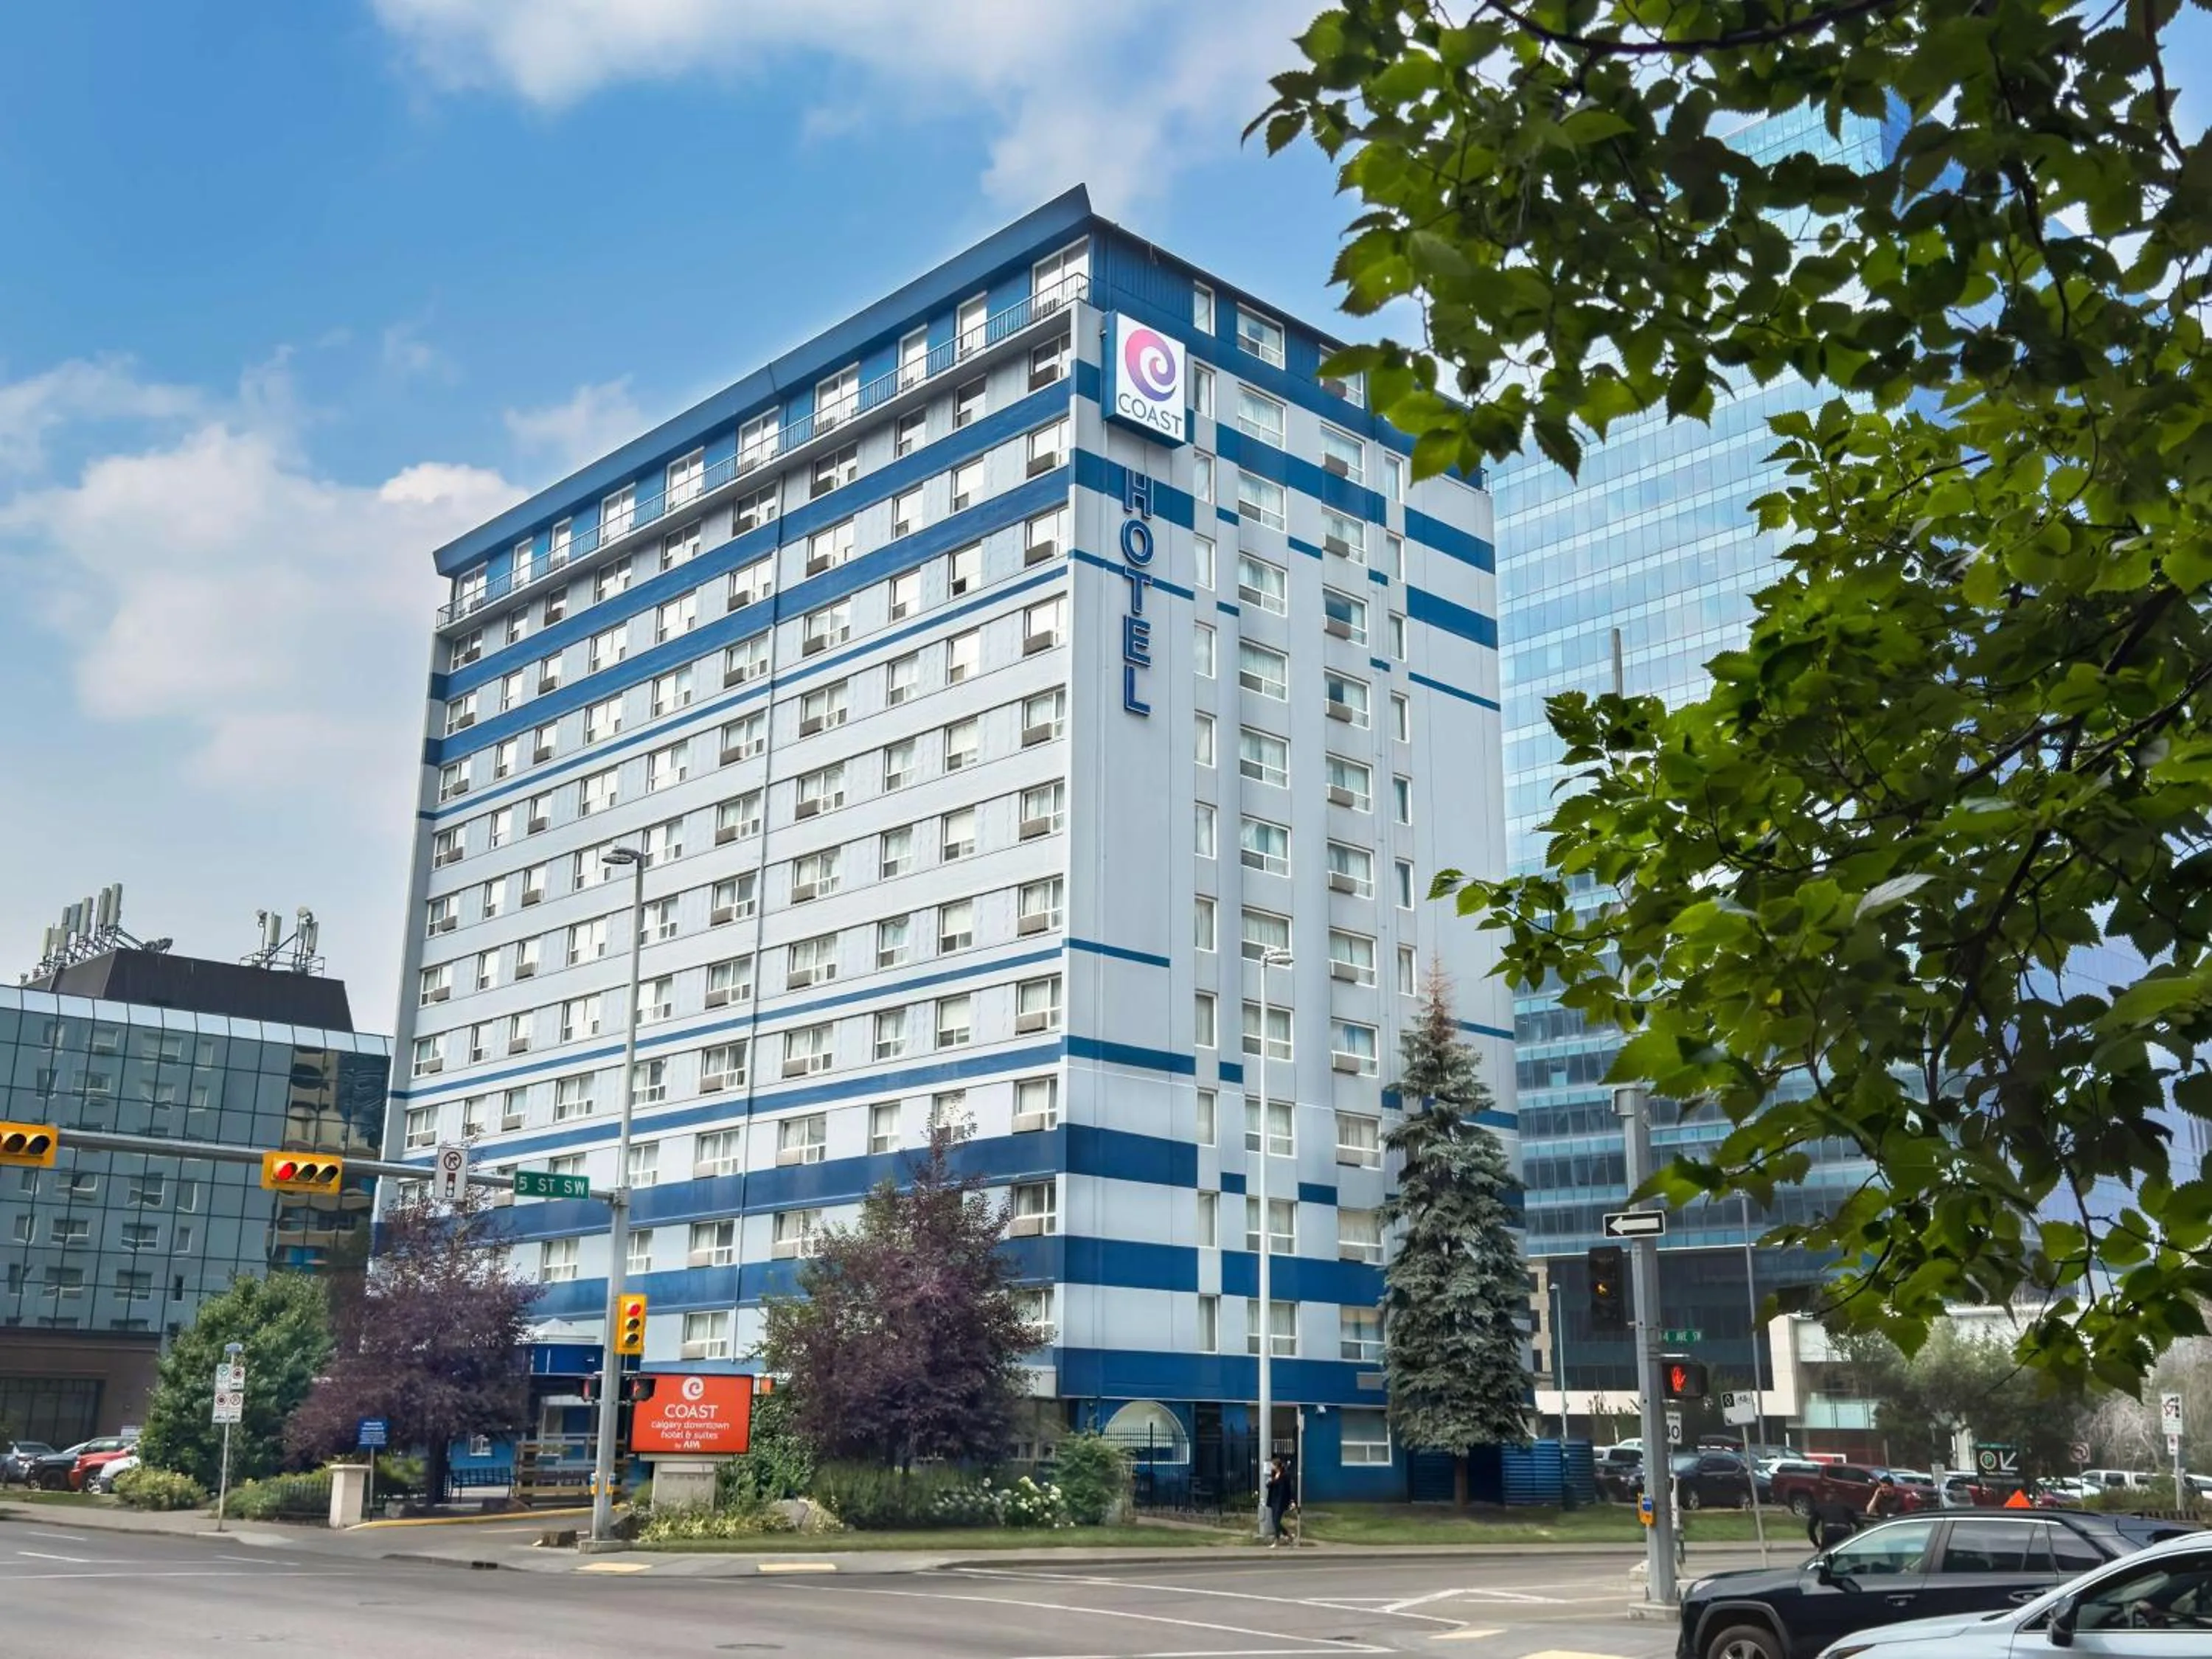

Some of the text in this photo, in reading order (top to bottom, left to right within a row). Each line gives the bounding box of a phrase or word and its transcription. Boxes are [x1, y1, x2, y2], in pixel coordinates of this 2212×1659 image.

[1118, 393, 1183, 434] COAST
[1121, 466, 1154, 715] HOTEL
[518, 1176, 585, 1195] 5 ST SW
[664, 1404, 718, 1419] COAST
[651, 1420, 730, 1430] calgary downtown
[661, 1430, 683, 1439] hotel
[693, 1431, 718, 1439] suites
